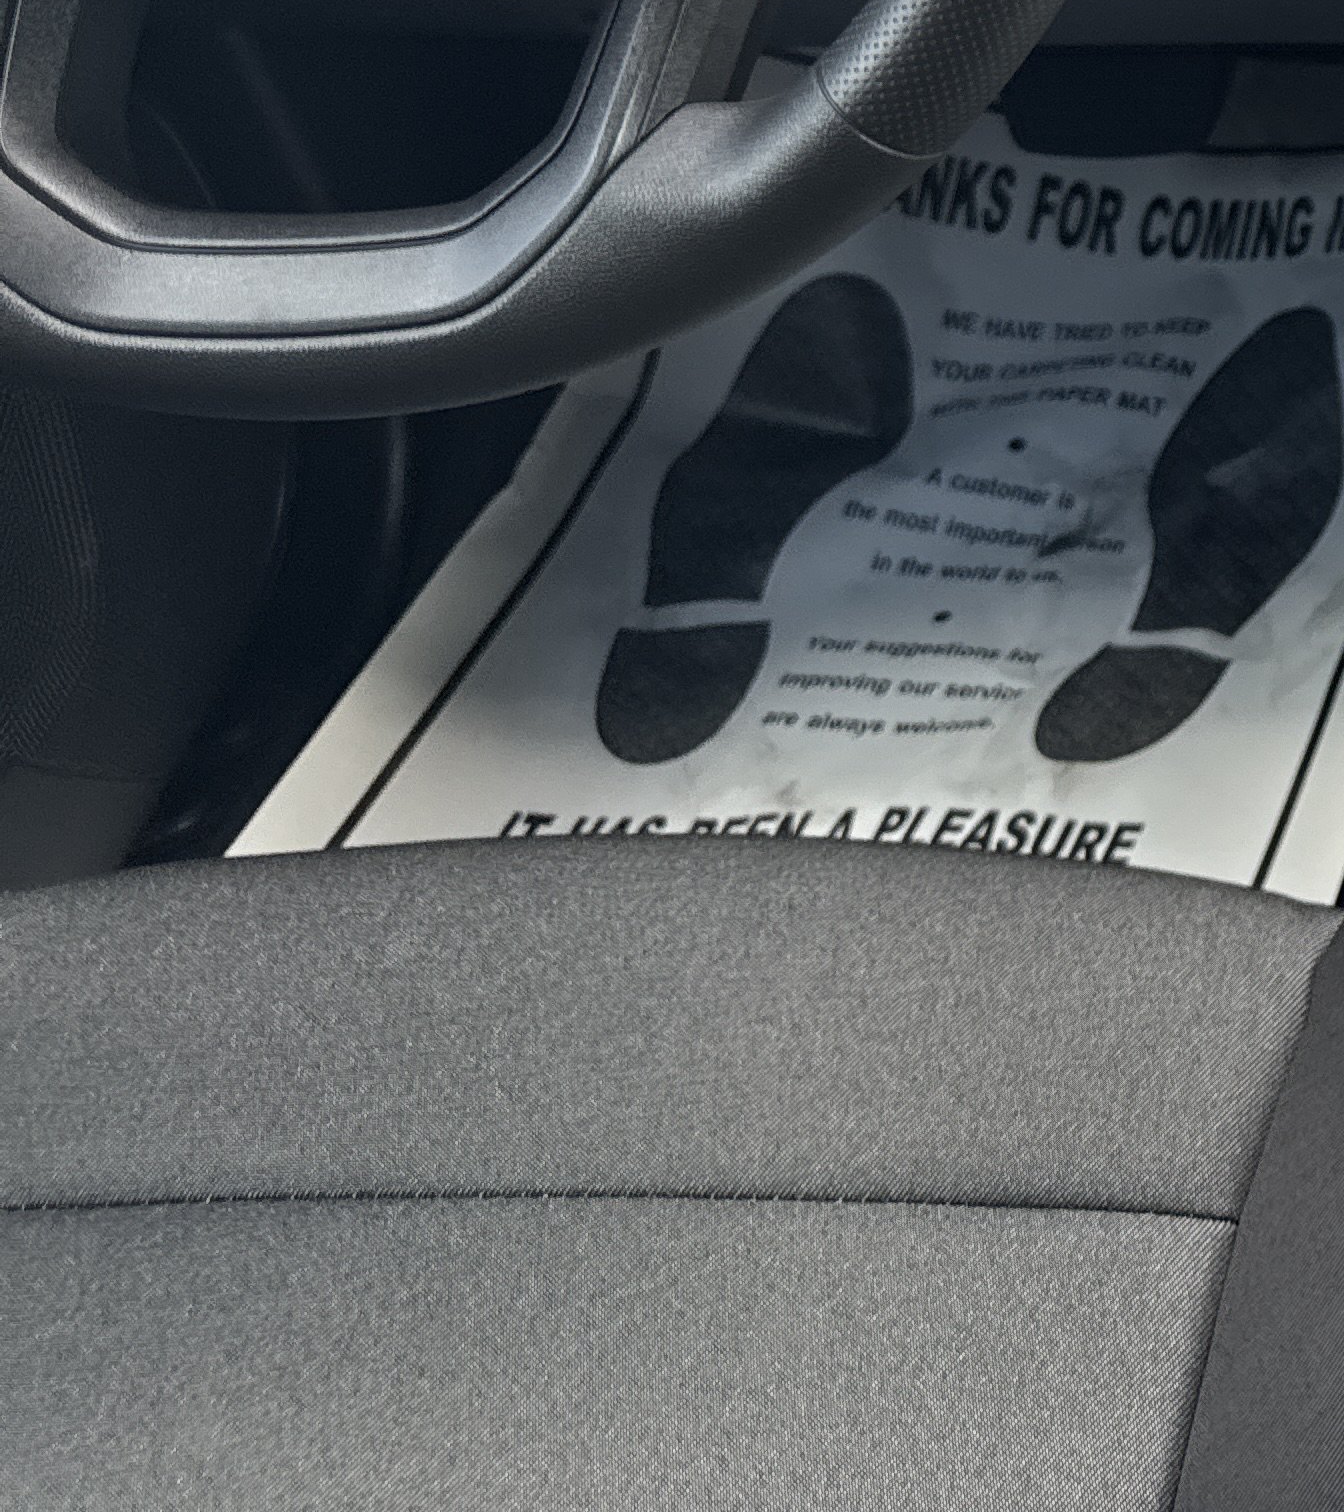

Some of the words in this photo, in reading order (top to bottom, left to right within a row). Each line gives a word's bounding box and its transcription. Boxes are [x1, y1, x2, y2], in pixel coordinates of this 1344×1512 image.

[1027, 172, 1127, 256] FOR
[1138, 193, 1315, 262] COMING
[941, 308, 977, 336] WE
[984, 318, 1044, 343] HAVE
[930, 358, 993, 383] YOUR
[1122, 351, 1196, 378] CLEAN
[1116, 391, 1167, 417] MAT
[925, 467, 943, 487] A
[949, 473, 1049, 507] customer
[1056, 490, 1075, 511] is
[843, 499, 877, 521] the
[883, 508, 940, 532] most
[870, 551, 892, 573] in
[899, 557, 933, 577] the
[778, 672, 892, 696] improving
[897, 679, 939, 696] our
[761, 710, 800, 727] are
[806, 712, 886, 737] always
[873, 806, 1145, 867] PLEASURE
